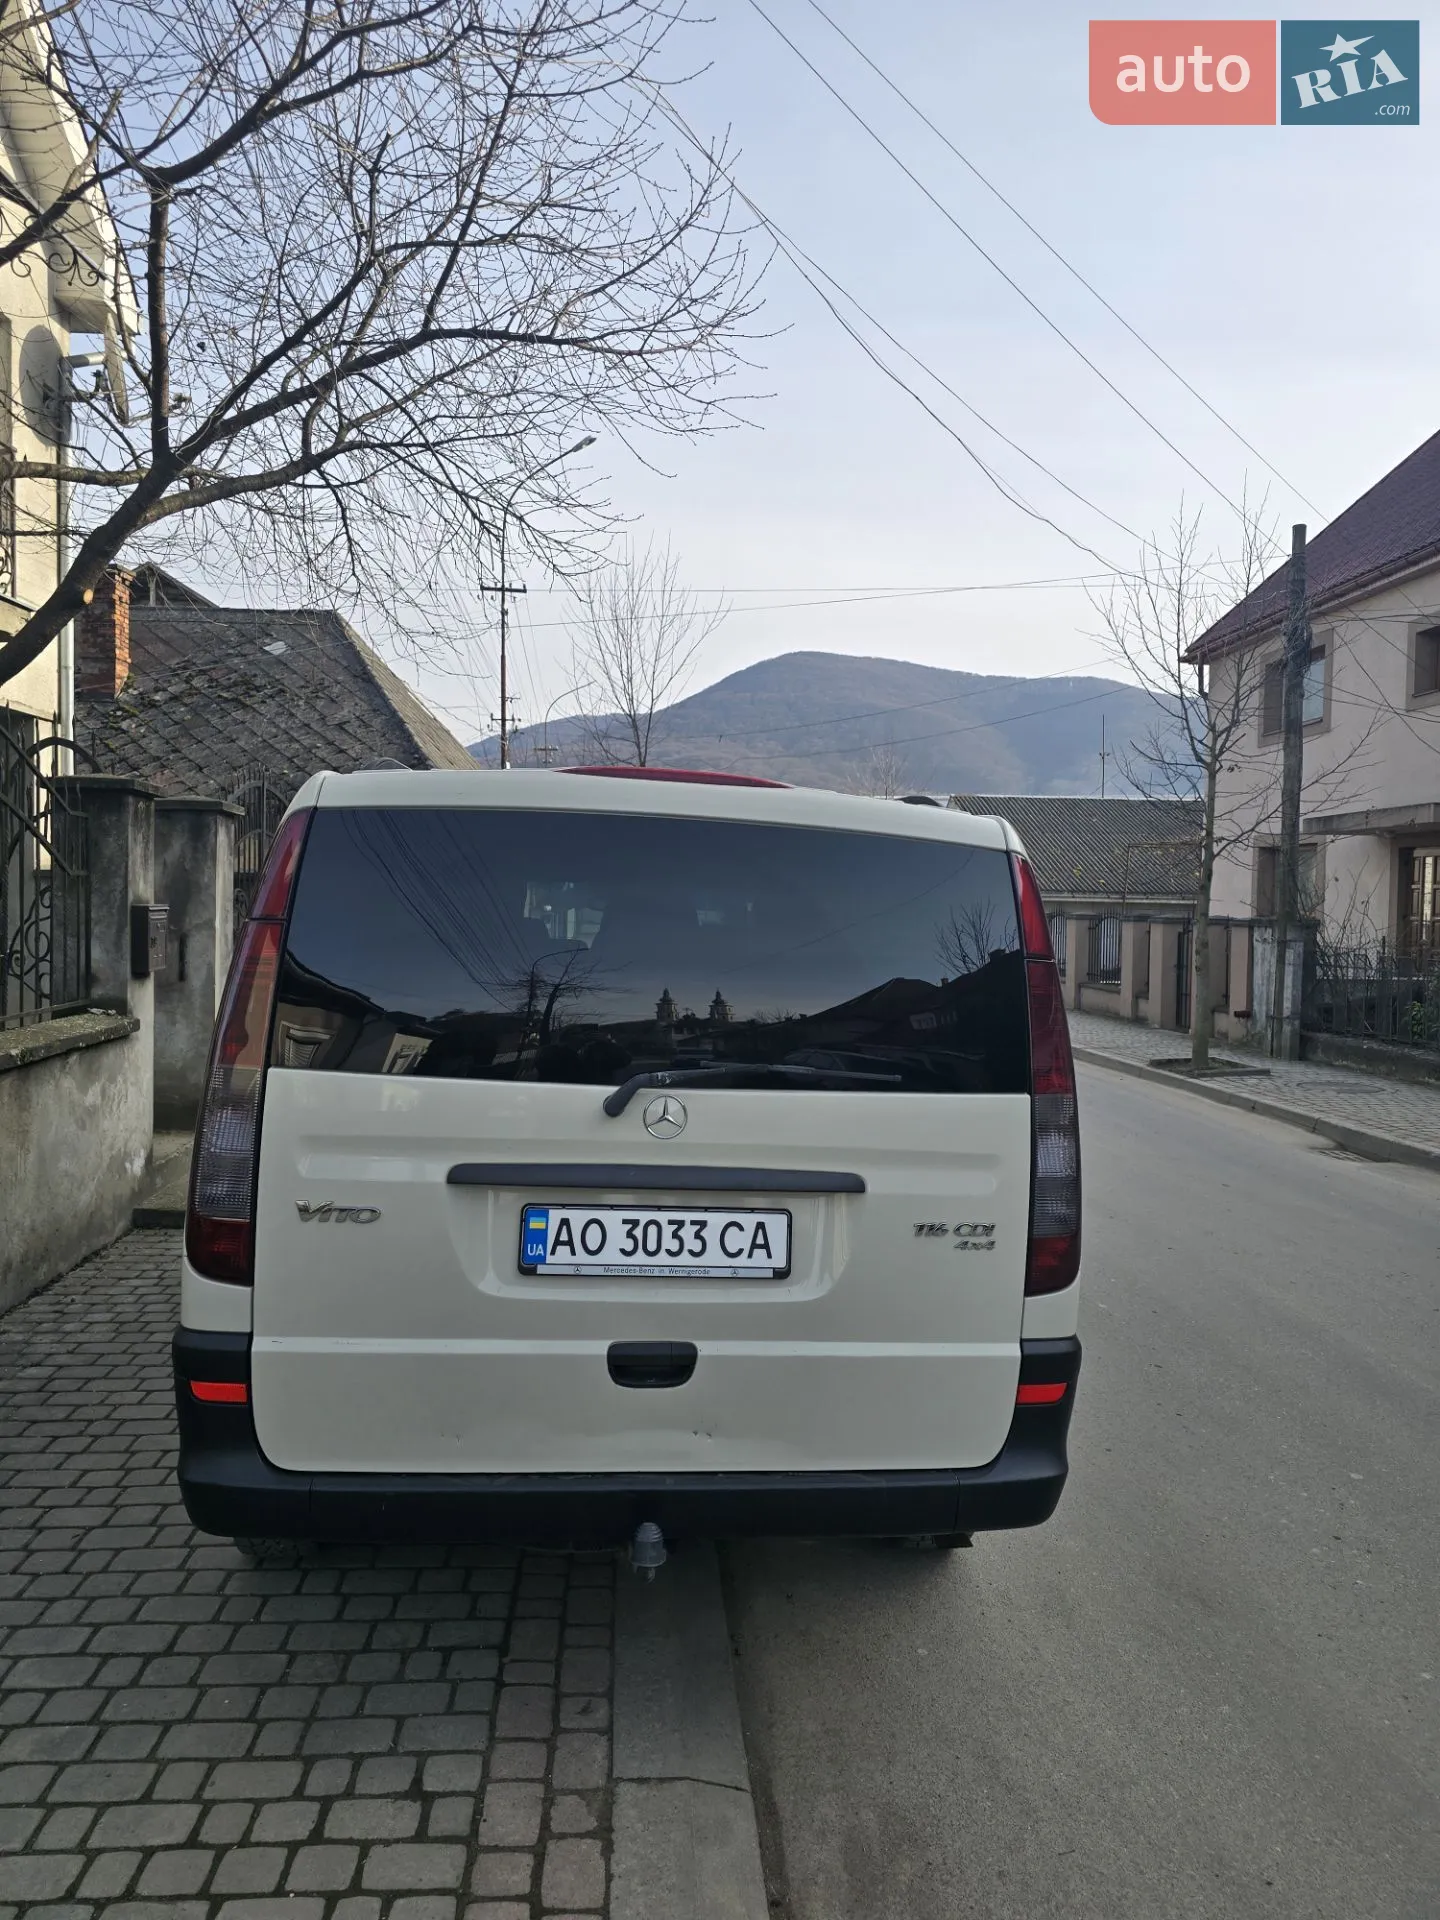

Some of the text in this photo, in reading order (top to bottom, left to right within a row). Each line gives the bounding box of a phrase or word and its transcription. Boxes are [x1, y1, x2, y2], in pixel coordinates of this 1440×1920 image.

[549, 1217, 772, 1259] AO 3033 CA
[527, 1243, 544, 1256] UA
[603, 1266, 655, 1275] Mercedes-Benz
